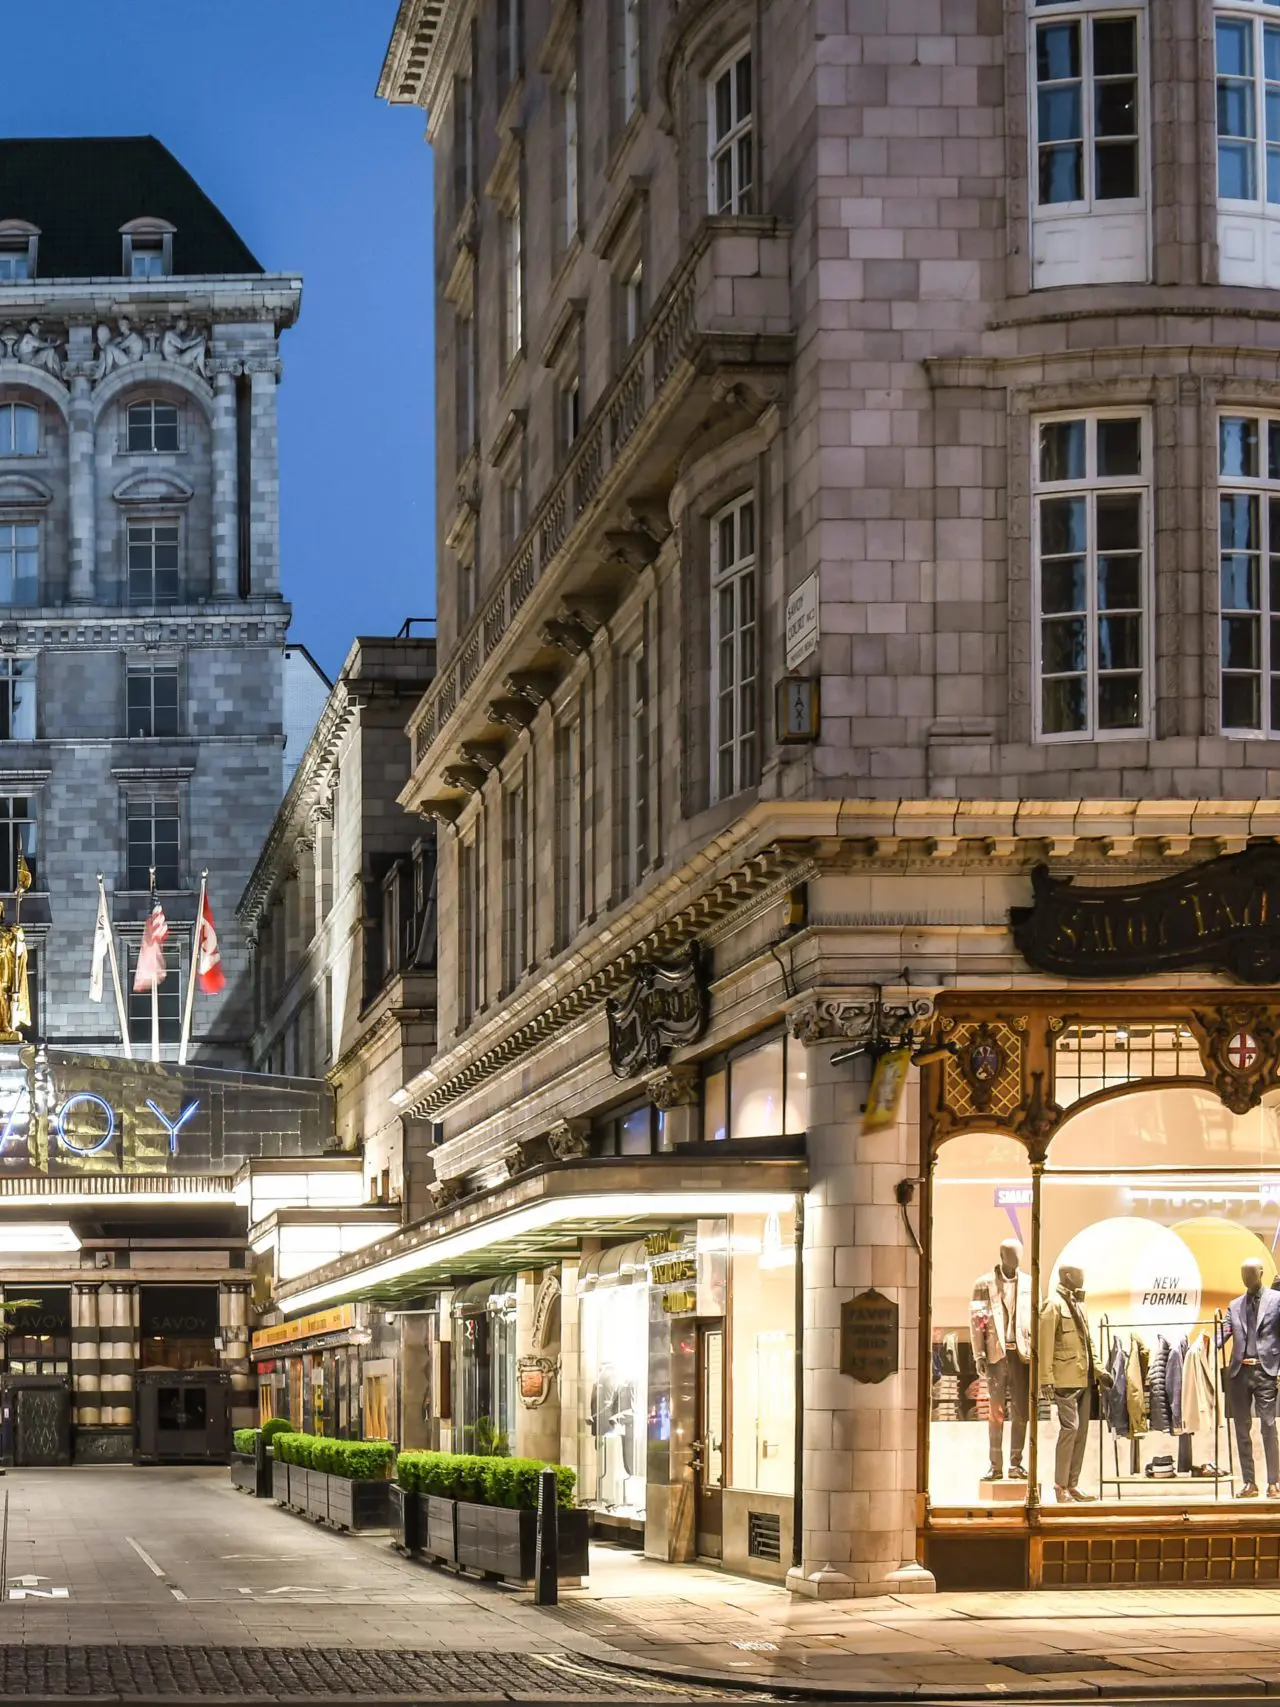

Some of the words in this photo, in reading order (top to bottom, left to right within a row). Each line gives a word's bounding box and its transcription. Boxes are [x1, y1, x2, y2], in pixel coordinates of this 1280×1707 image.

[794, 684, 804, 731] TAXI
[1153, 1277, 1180, 1289] NEW
[1142, 1293, 1188, 1305] FORMAL
[151, 1316, 208, 1331] SAVOY
